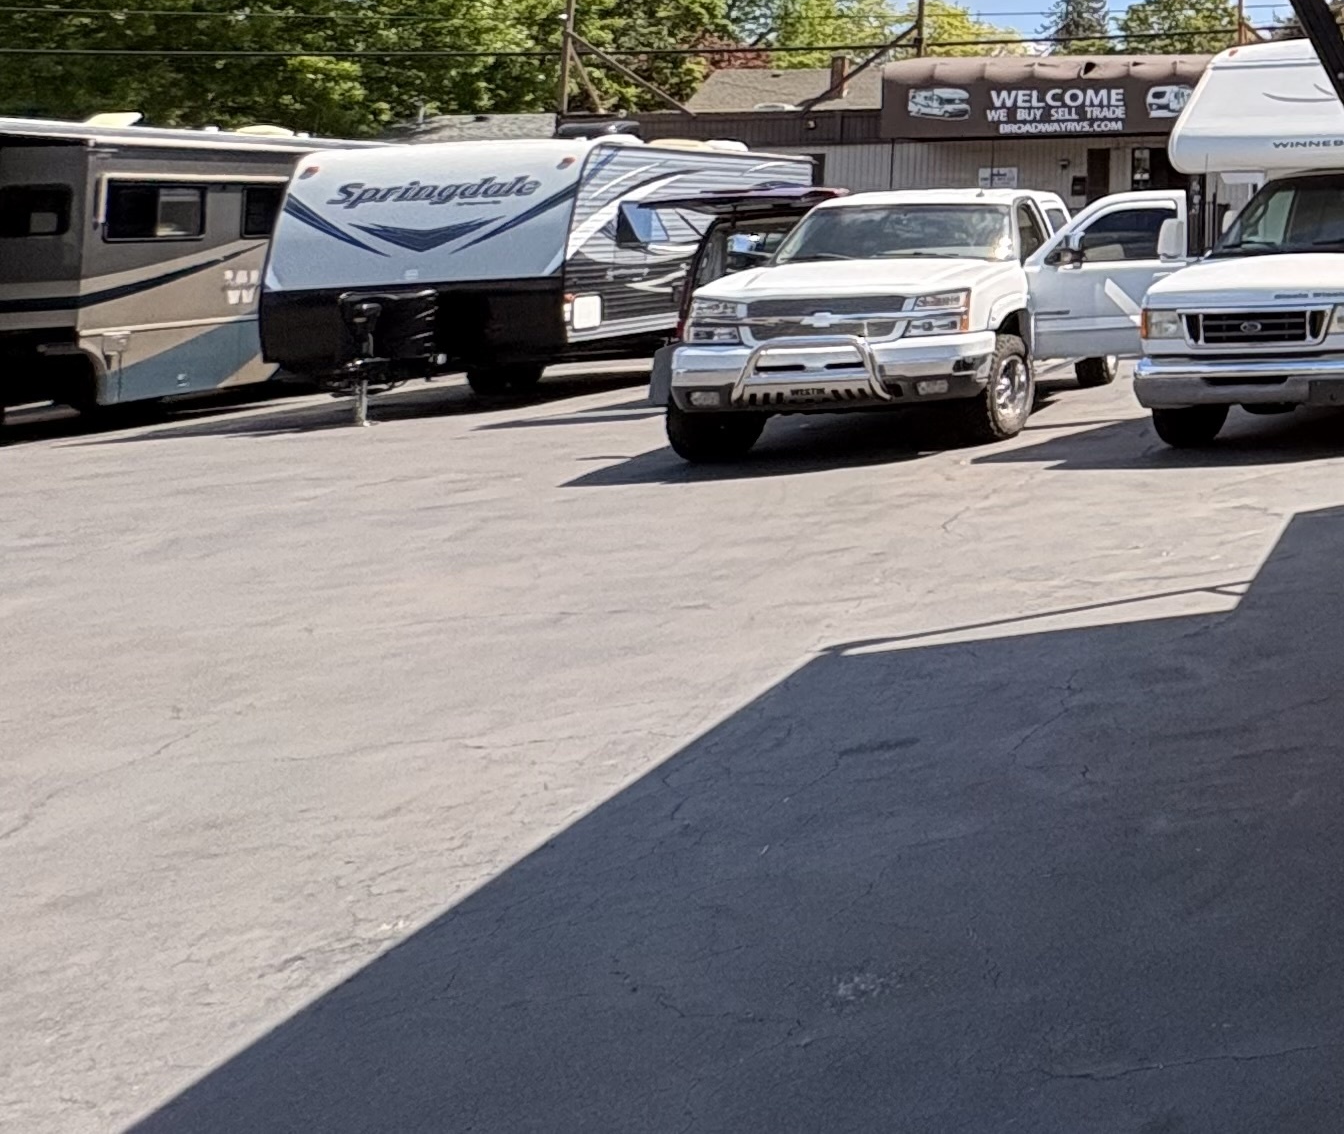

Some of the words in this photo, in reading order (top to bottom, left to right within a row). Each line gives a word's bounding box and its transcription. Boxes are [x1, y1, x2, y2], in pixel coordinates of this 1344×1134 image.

[990, 88, 1125, 108] WELCOME
[986, 109, 1008, 122] WE
[1016, 108, 1043, 121] BUY
[1051, 107, 1079, 120] SELL
[1085, 106, 1126, 119] TRADE
[1000, 120, 1122, 134] BROADWAYRVS.COM
[326, 175, 541, 209] Springdale
